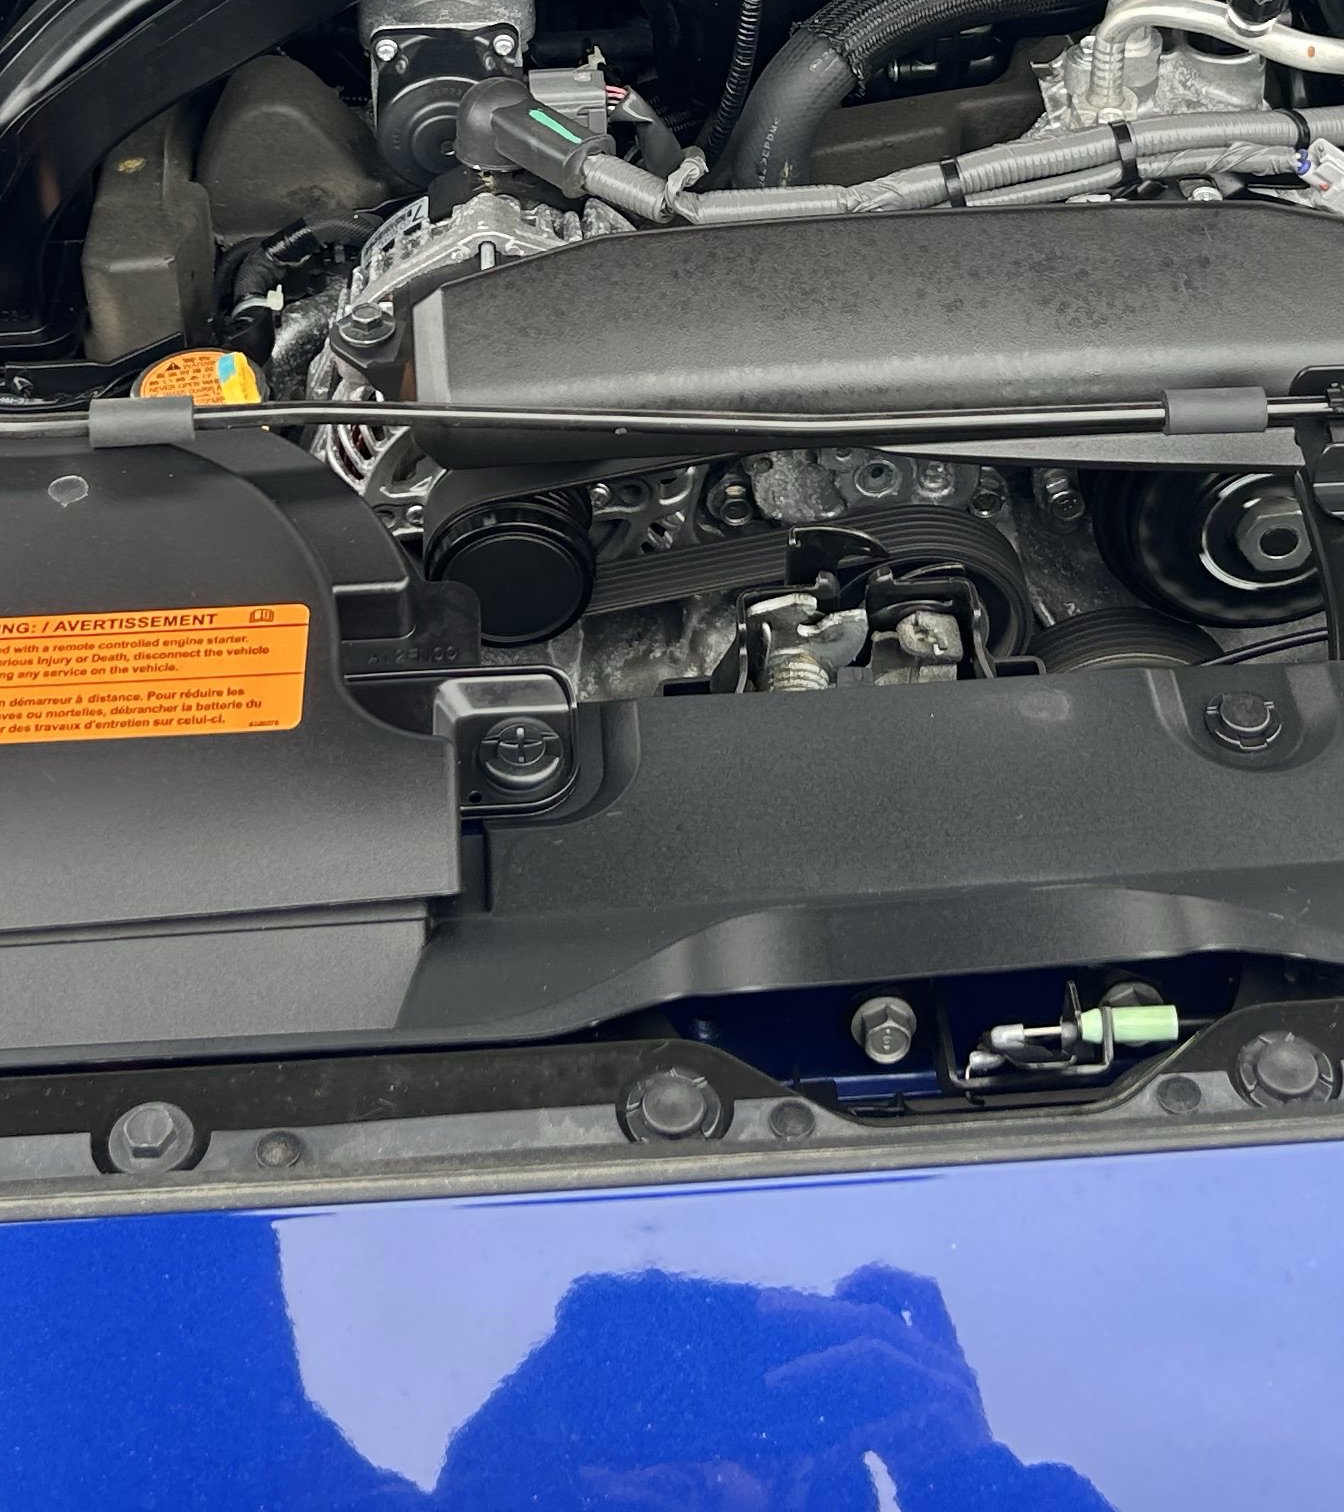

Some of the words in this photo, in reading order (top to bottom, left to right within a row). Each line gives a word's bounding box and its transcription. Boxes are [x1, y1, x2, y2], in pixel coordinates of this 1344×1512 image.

[54, 613, 218, 632] AVERTISSEMENT
[14, 644, 39, 654] with
[53, 643, 96, 652] remote
[98, 638, 160, 649] controlled
[163, 637, 204, 648] engine
[207, 635, 249, 644] starter.
[76, 654, 89, 664] or
[91, 652, 130, 663] Death,
[134, 649, 201, 660] disconnect
[204, 648, 223, 658] the
[226, 646, 270, 656] vehicle
[17, 670, 40, 680] any
[43, 667, 87, 678] service
[90, 666, 107, 675] on
[110, 665, 129, 675] the
[132, 663, 179, 673] vehicle.
[9, 696, 72, 707] démarreur
[88, 692, 143, 703] distance.
[147, 690, 175, 701] Pour
[179, 688, 223, 699] réduire
[226, 687, 245, 697] les
[26, 712, 42, 720] ou
[46, 707, 107, 719] mortelles,
[110, 704, 178, 716] débrancher
[182, 703, 192, 712] la
[196, 700, 243, 711] batterie
[246, 699, 262, 709] du
[8, 723, 31, 734] des
[34, 721, 80, 733] travaux
[84, 718, 151, 730] d'entretien
[153, 717, 175, 727] sur
[177, 714, 225, 726] celui-ci.
